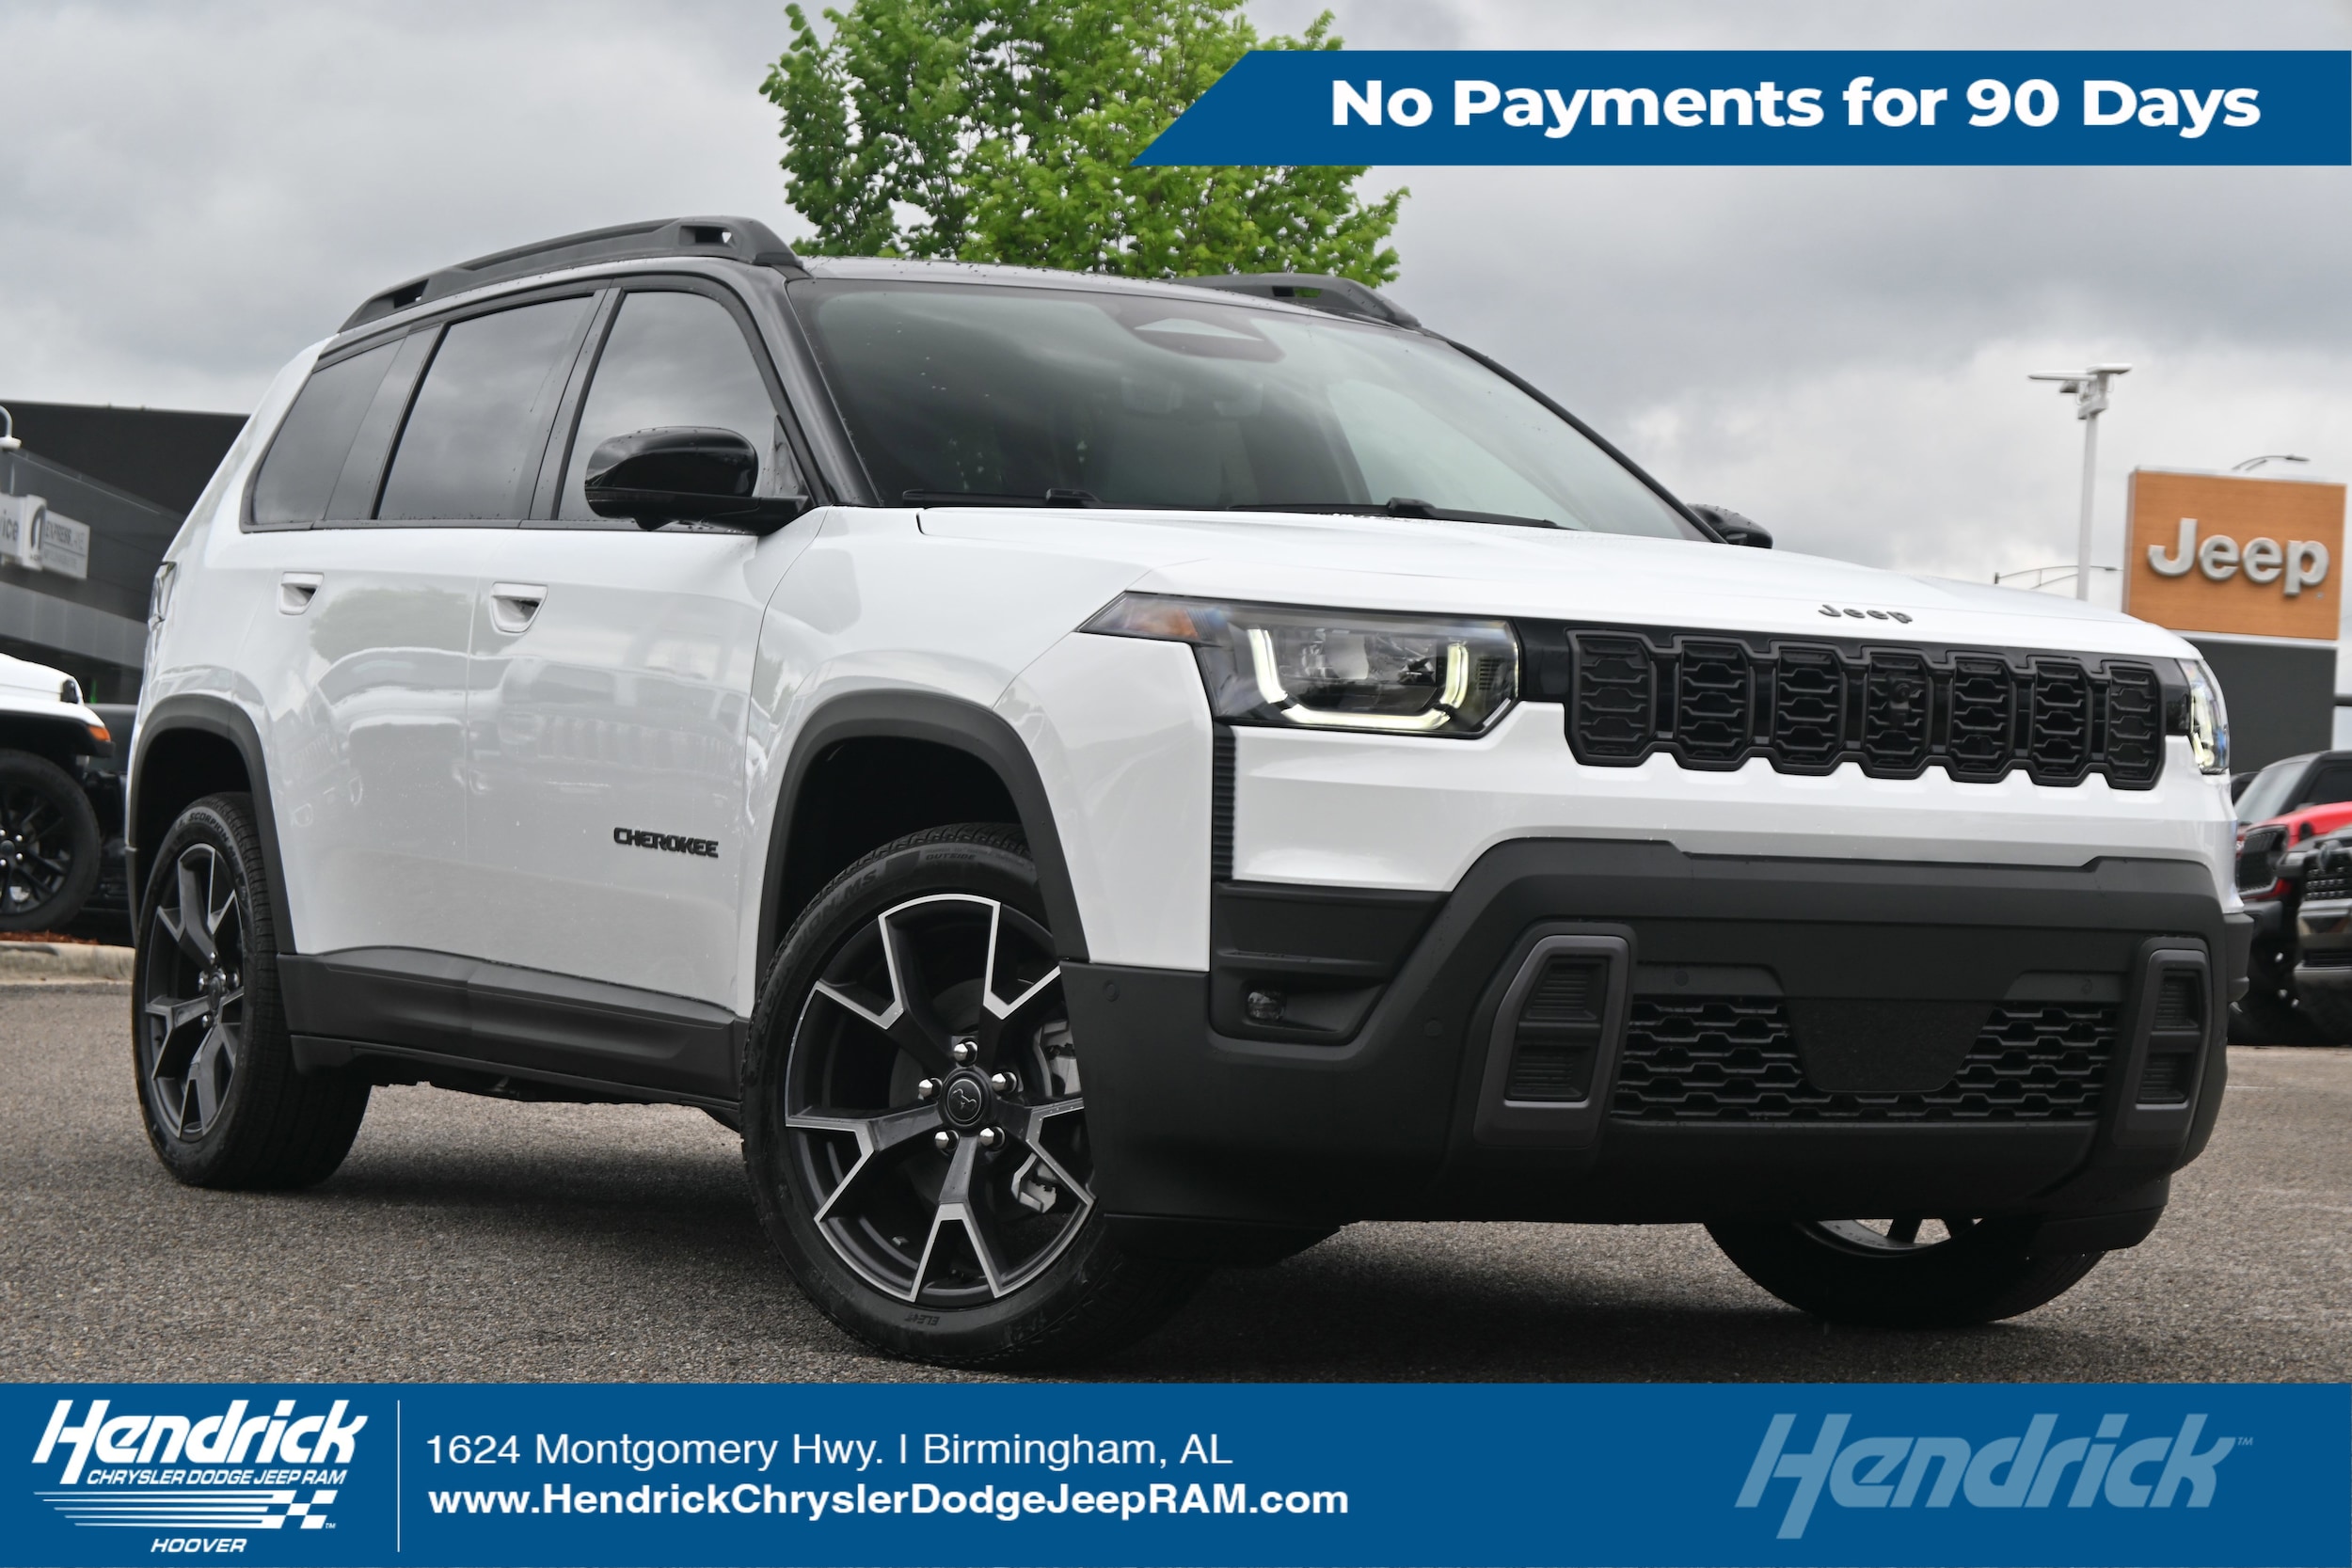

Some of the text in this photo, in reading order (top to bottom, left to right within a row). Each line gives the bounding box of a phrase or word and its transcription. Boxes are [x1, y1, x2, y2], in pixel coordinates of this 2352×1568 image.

[0, 509, 19, 543] ice
[2147, 516, 2330, 597] Jeep
[1818, 604, 1913, 624] Jeep
[188, 812, 229, 843] SCORPION
[613, 827, 719, 858] CHEROKEE
[925, 852, 977, 861] OUTSIDE
